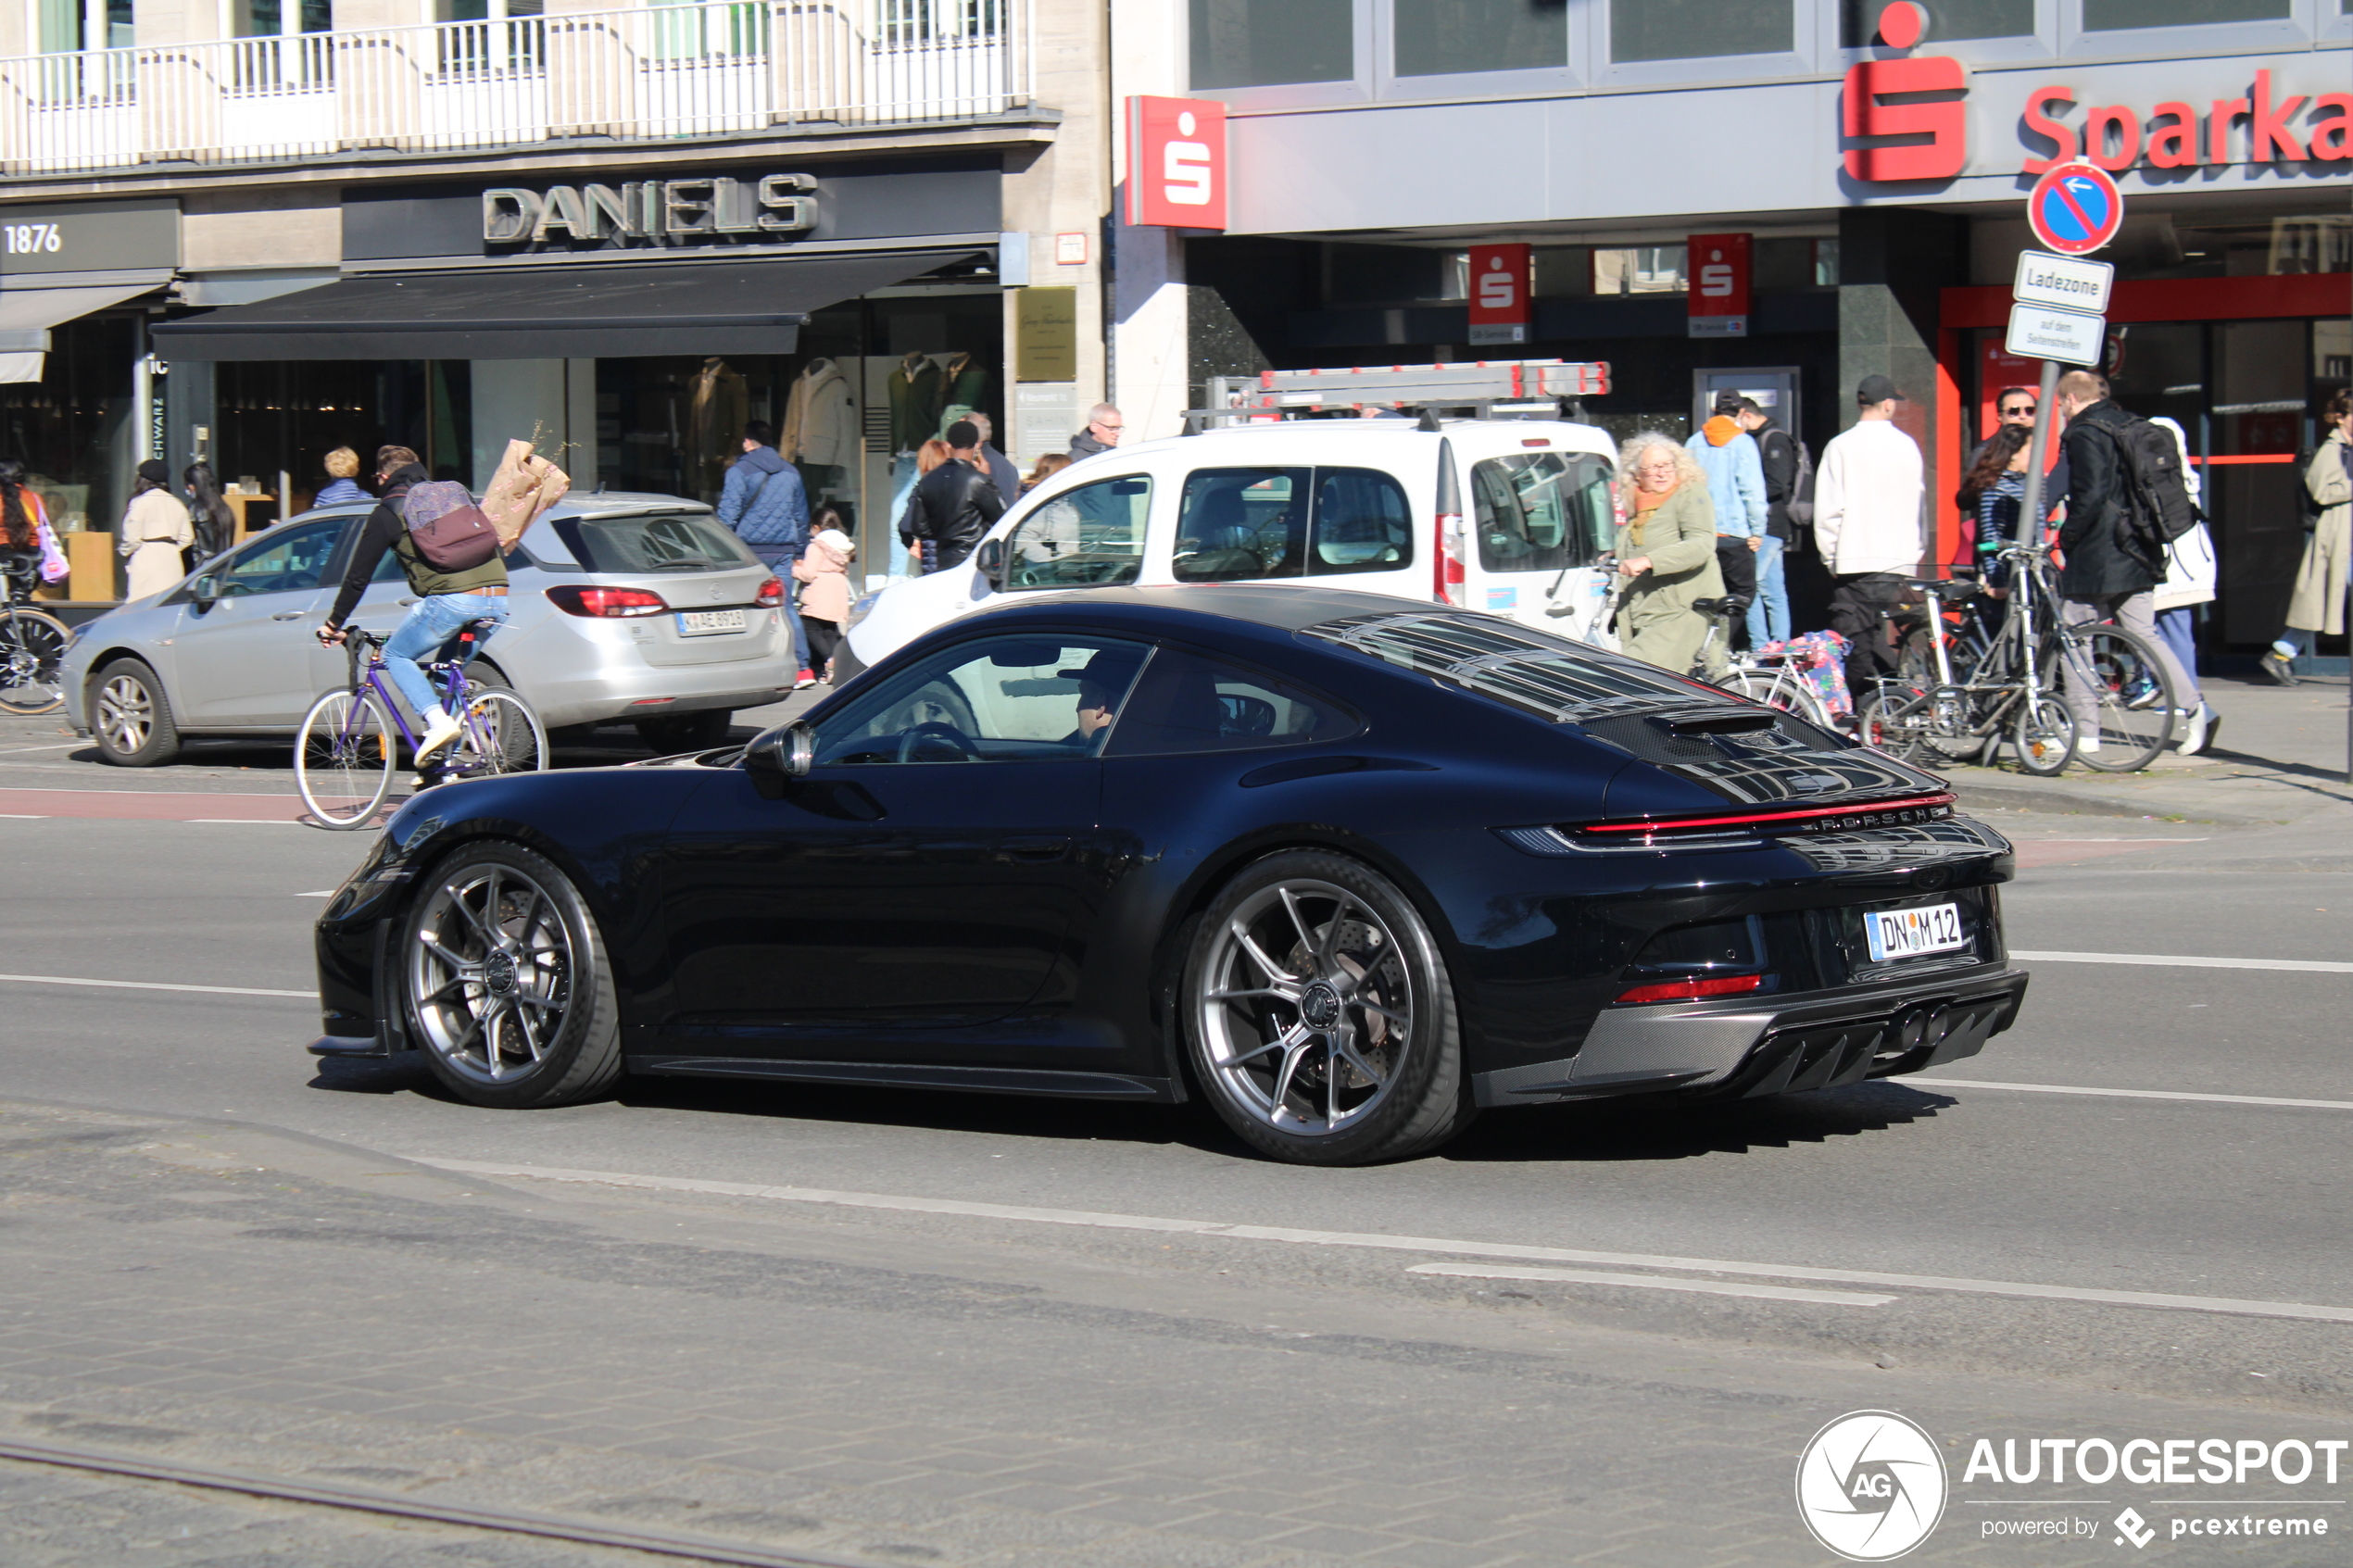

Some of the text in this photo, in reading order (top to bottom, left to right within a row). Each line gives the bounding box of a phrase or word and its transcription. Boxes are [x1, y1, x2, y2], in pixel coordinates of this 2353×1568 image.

[483, 173, 819, 244] DANIELS
[4, 223, 62, 254] 1876
[2026, 268, 2099, 295] Ladezone
[2026, 332, 2082, 351] Seitenstreifen
[153, 398, 164, 460] CHWARZ
[1821, 807, 1941, 832] PORSCHE
[1881, 909, 1958, 952] DN M 12
